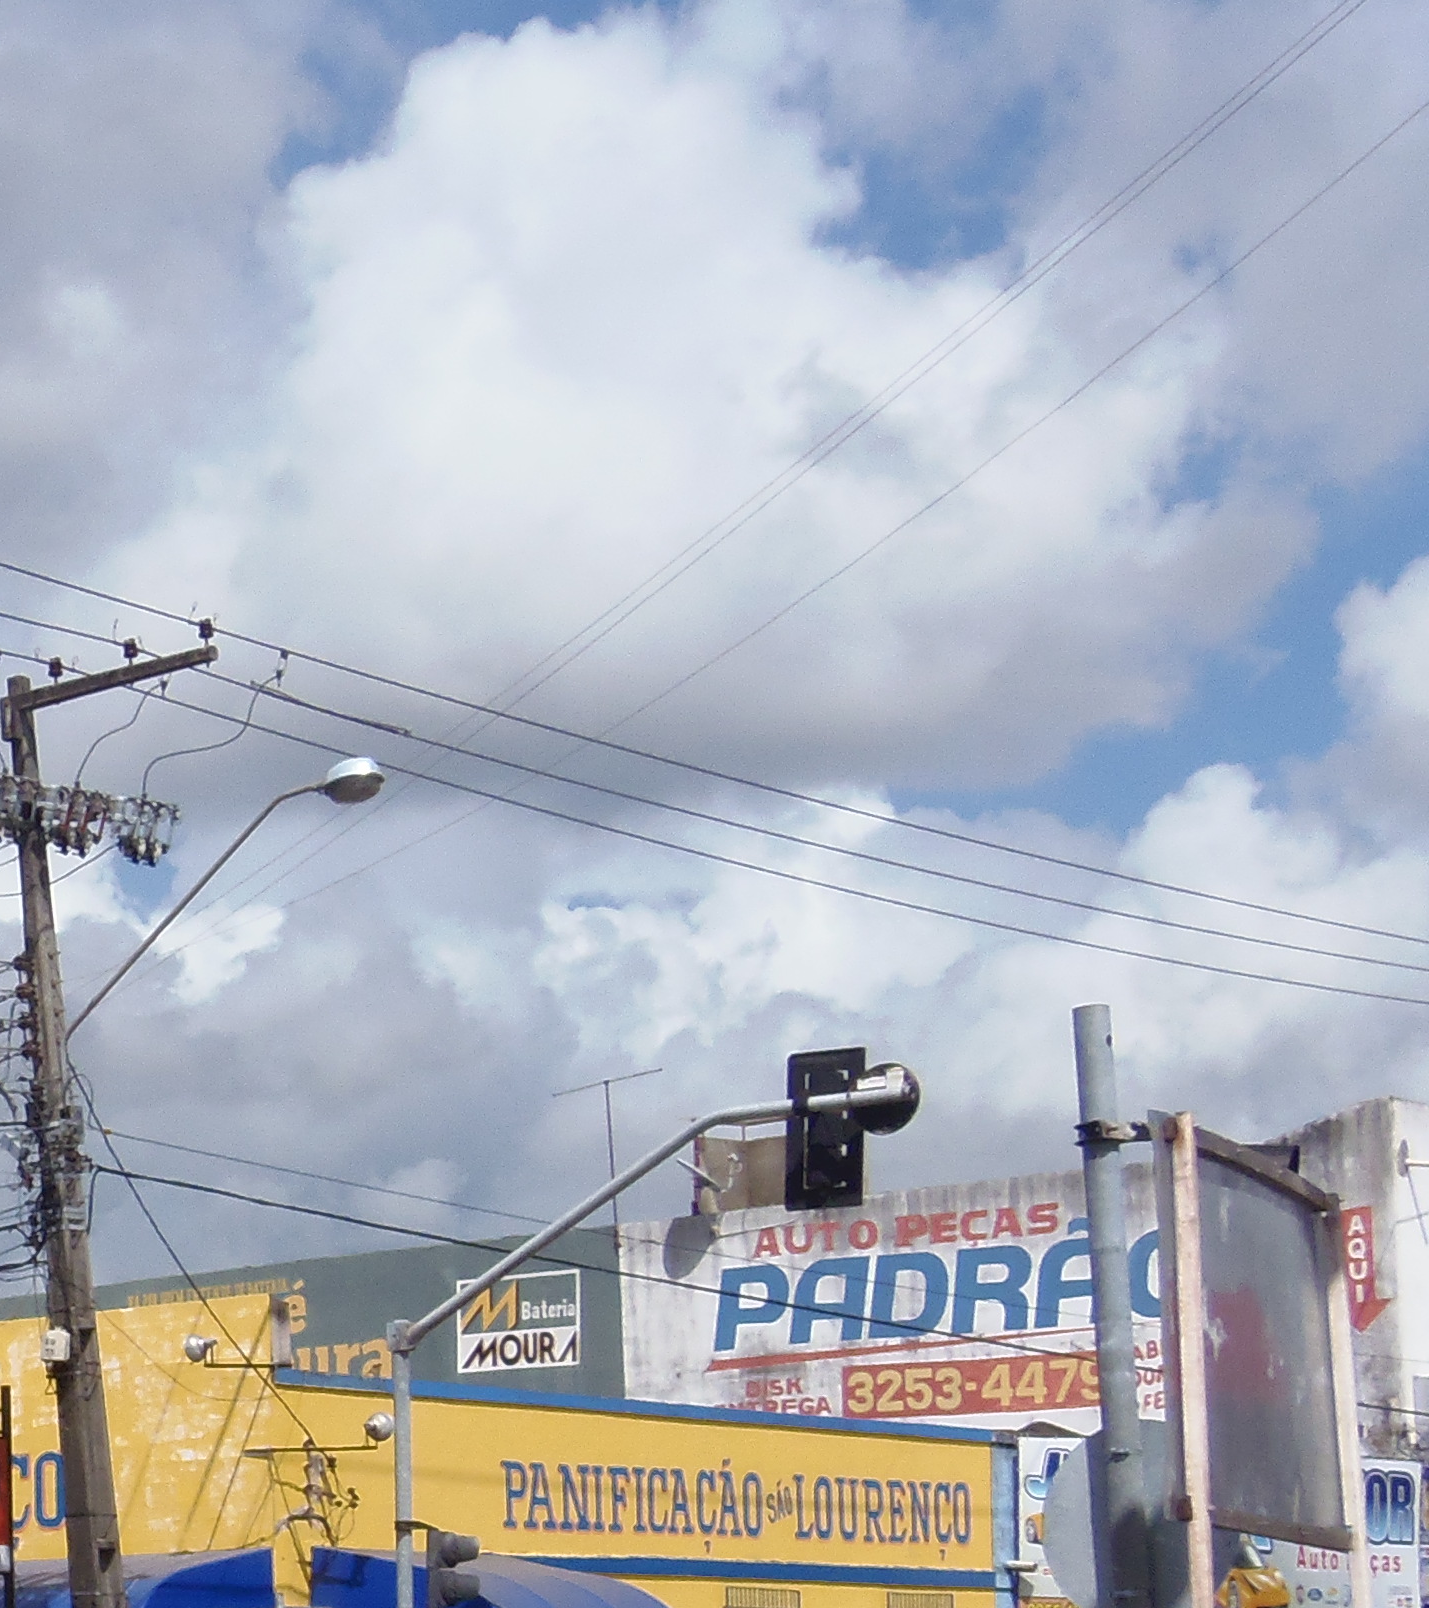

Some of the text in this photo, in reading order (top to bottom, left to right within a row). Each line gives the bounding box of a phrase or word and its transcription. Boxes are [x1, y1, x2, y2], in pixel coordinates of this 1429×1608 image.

[752, 1202, 1059, 1258] AUTO PEÇAS
[1346, 1214, 1368, 1303] AQUI
[521, 1298, 575, 1320] Bateria
[462, 1331, 577, 1369] MOURA
[745, 1377, 803, 1398] DISK
[847, 1359, 1099, 1416] 3253-4479
[793, 1472, 971, 1561] LOURENÇO
[1296, 1545, 1339, 1570] Auto
